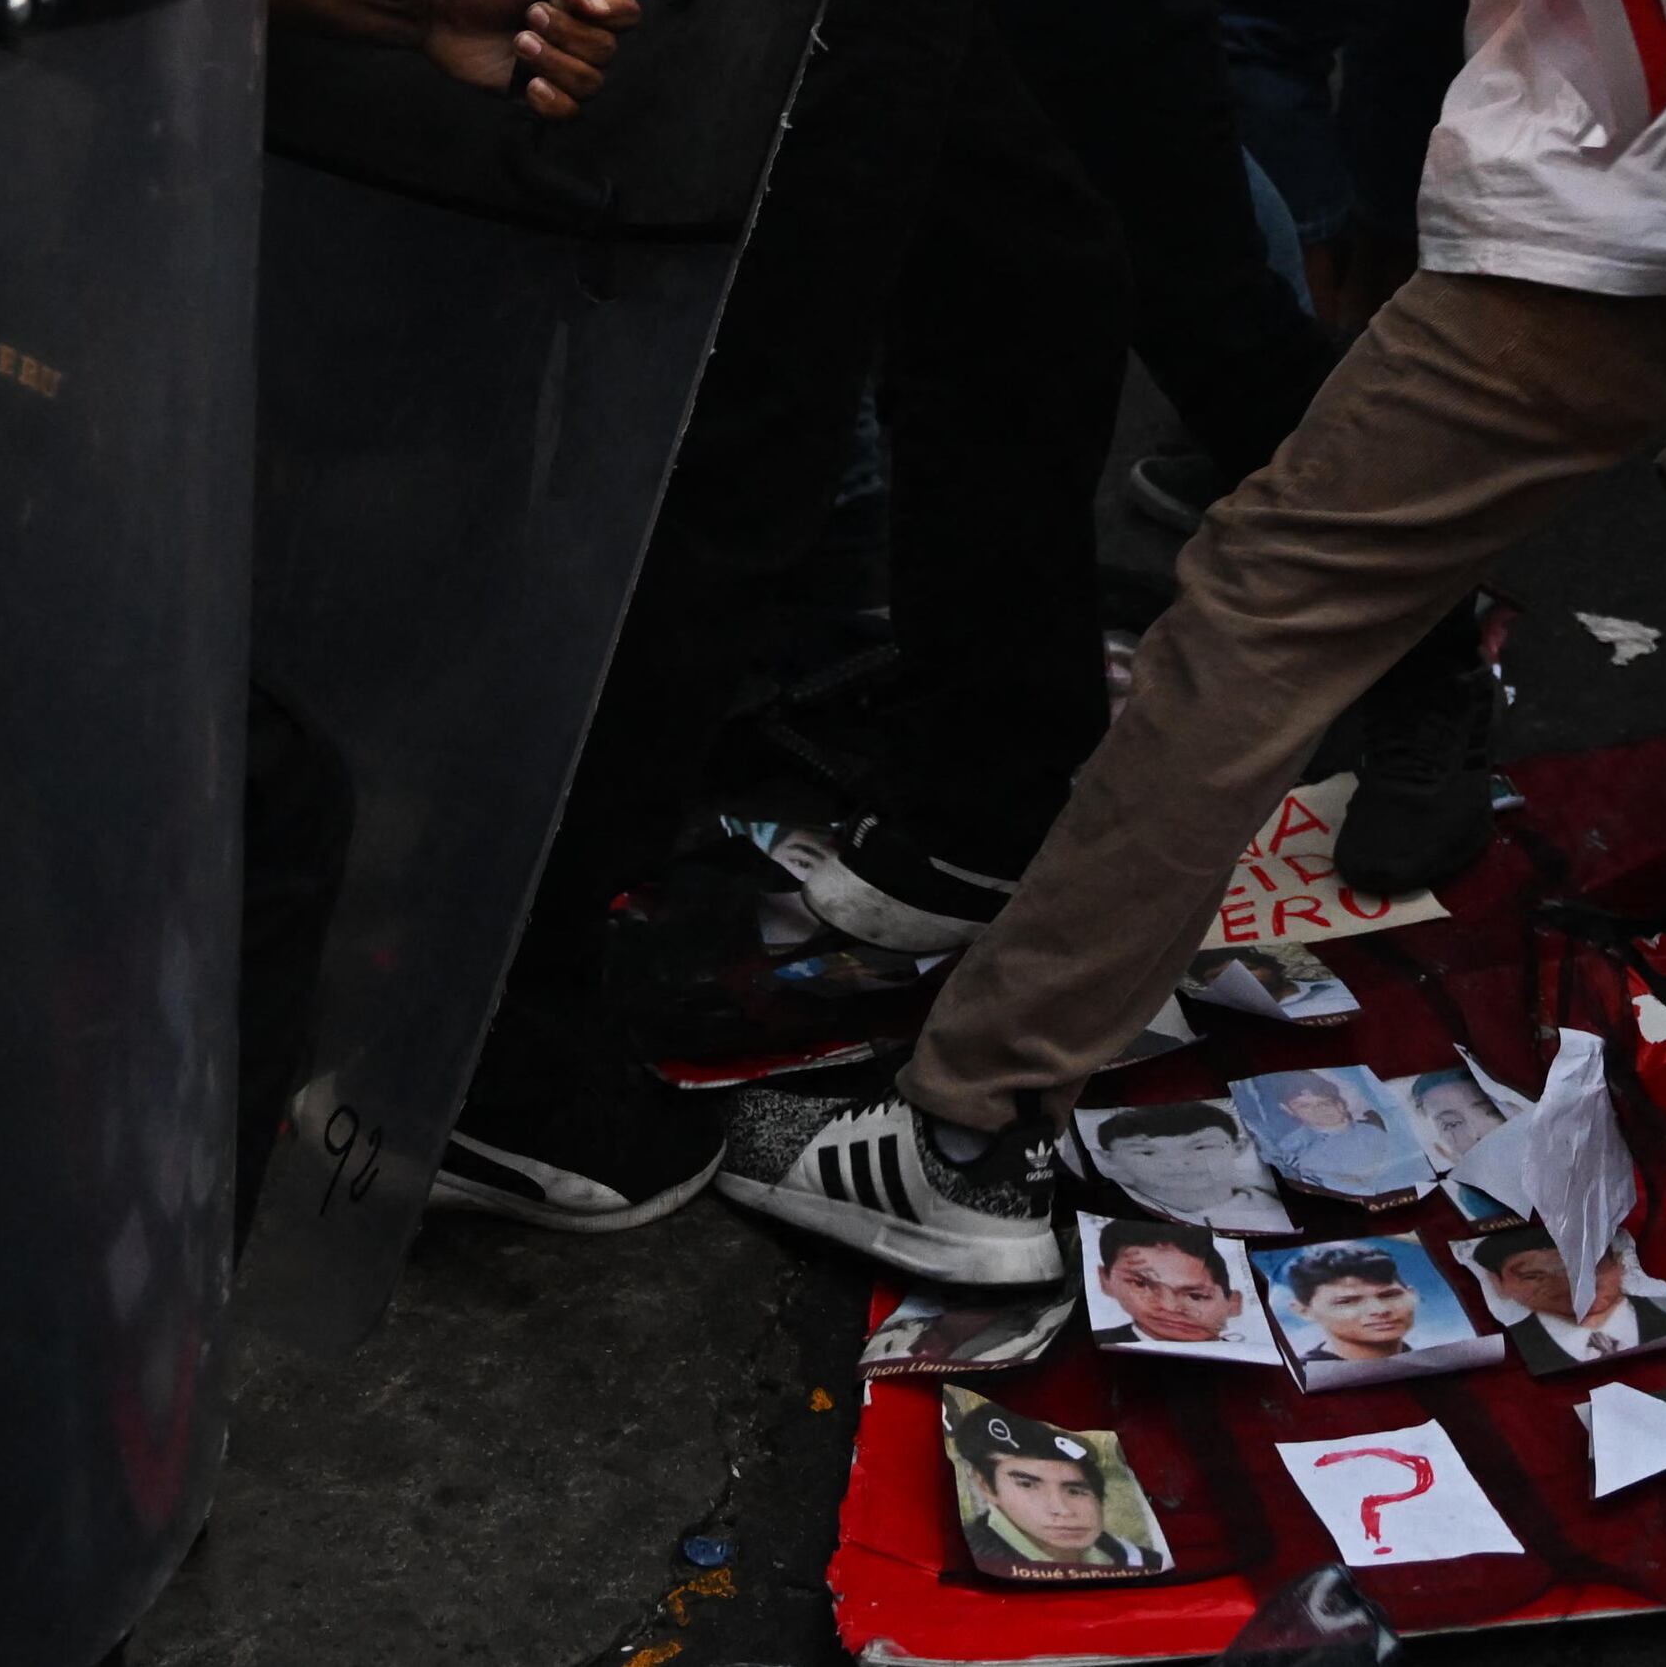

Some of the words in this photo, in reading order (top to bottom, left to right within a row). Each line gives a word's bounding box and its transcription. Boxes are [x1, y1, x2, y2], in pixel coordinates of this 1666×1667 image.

[319, 1103, 383, 1218] 92
[863, 1364, 904, 1380] Jhon
[1011, 1565, 1064, 1580] Josué
